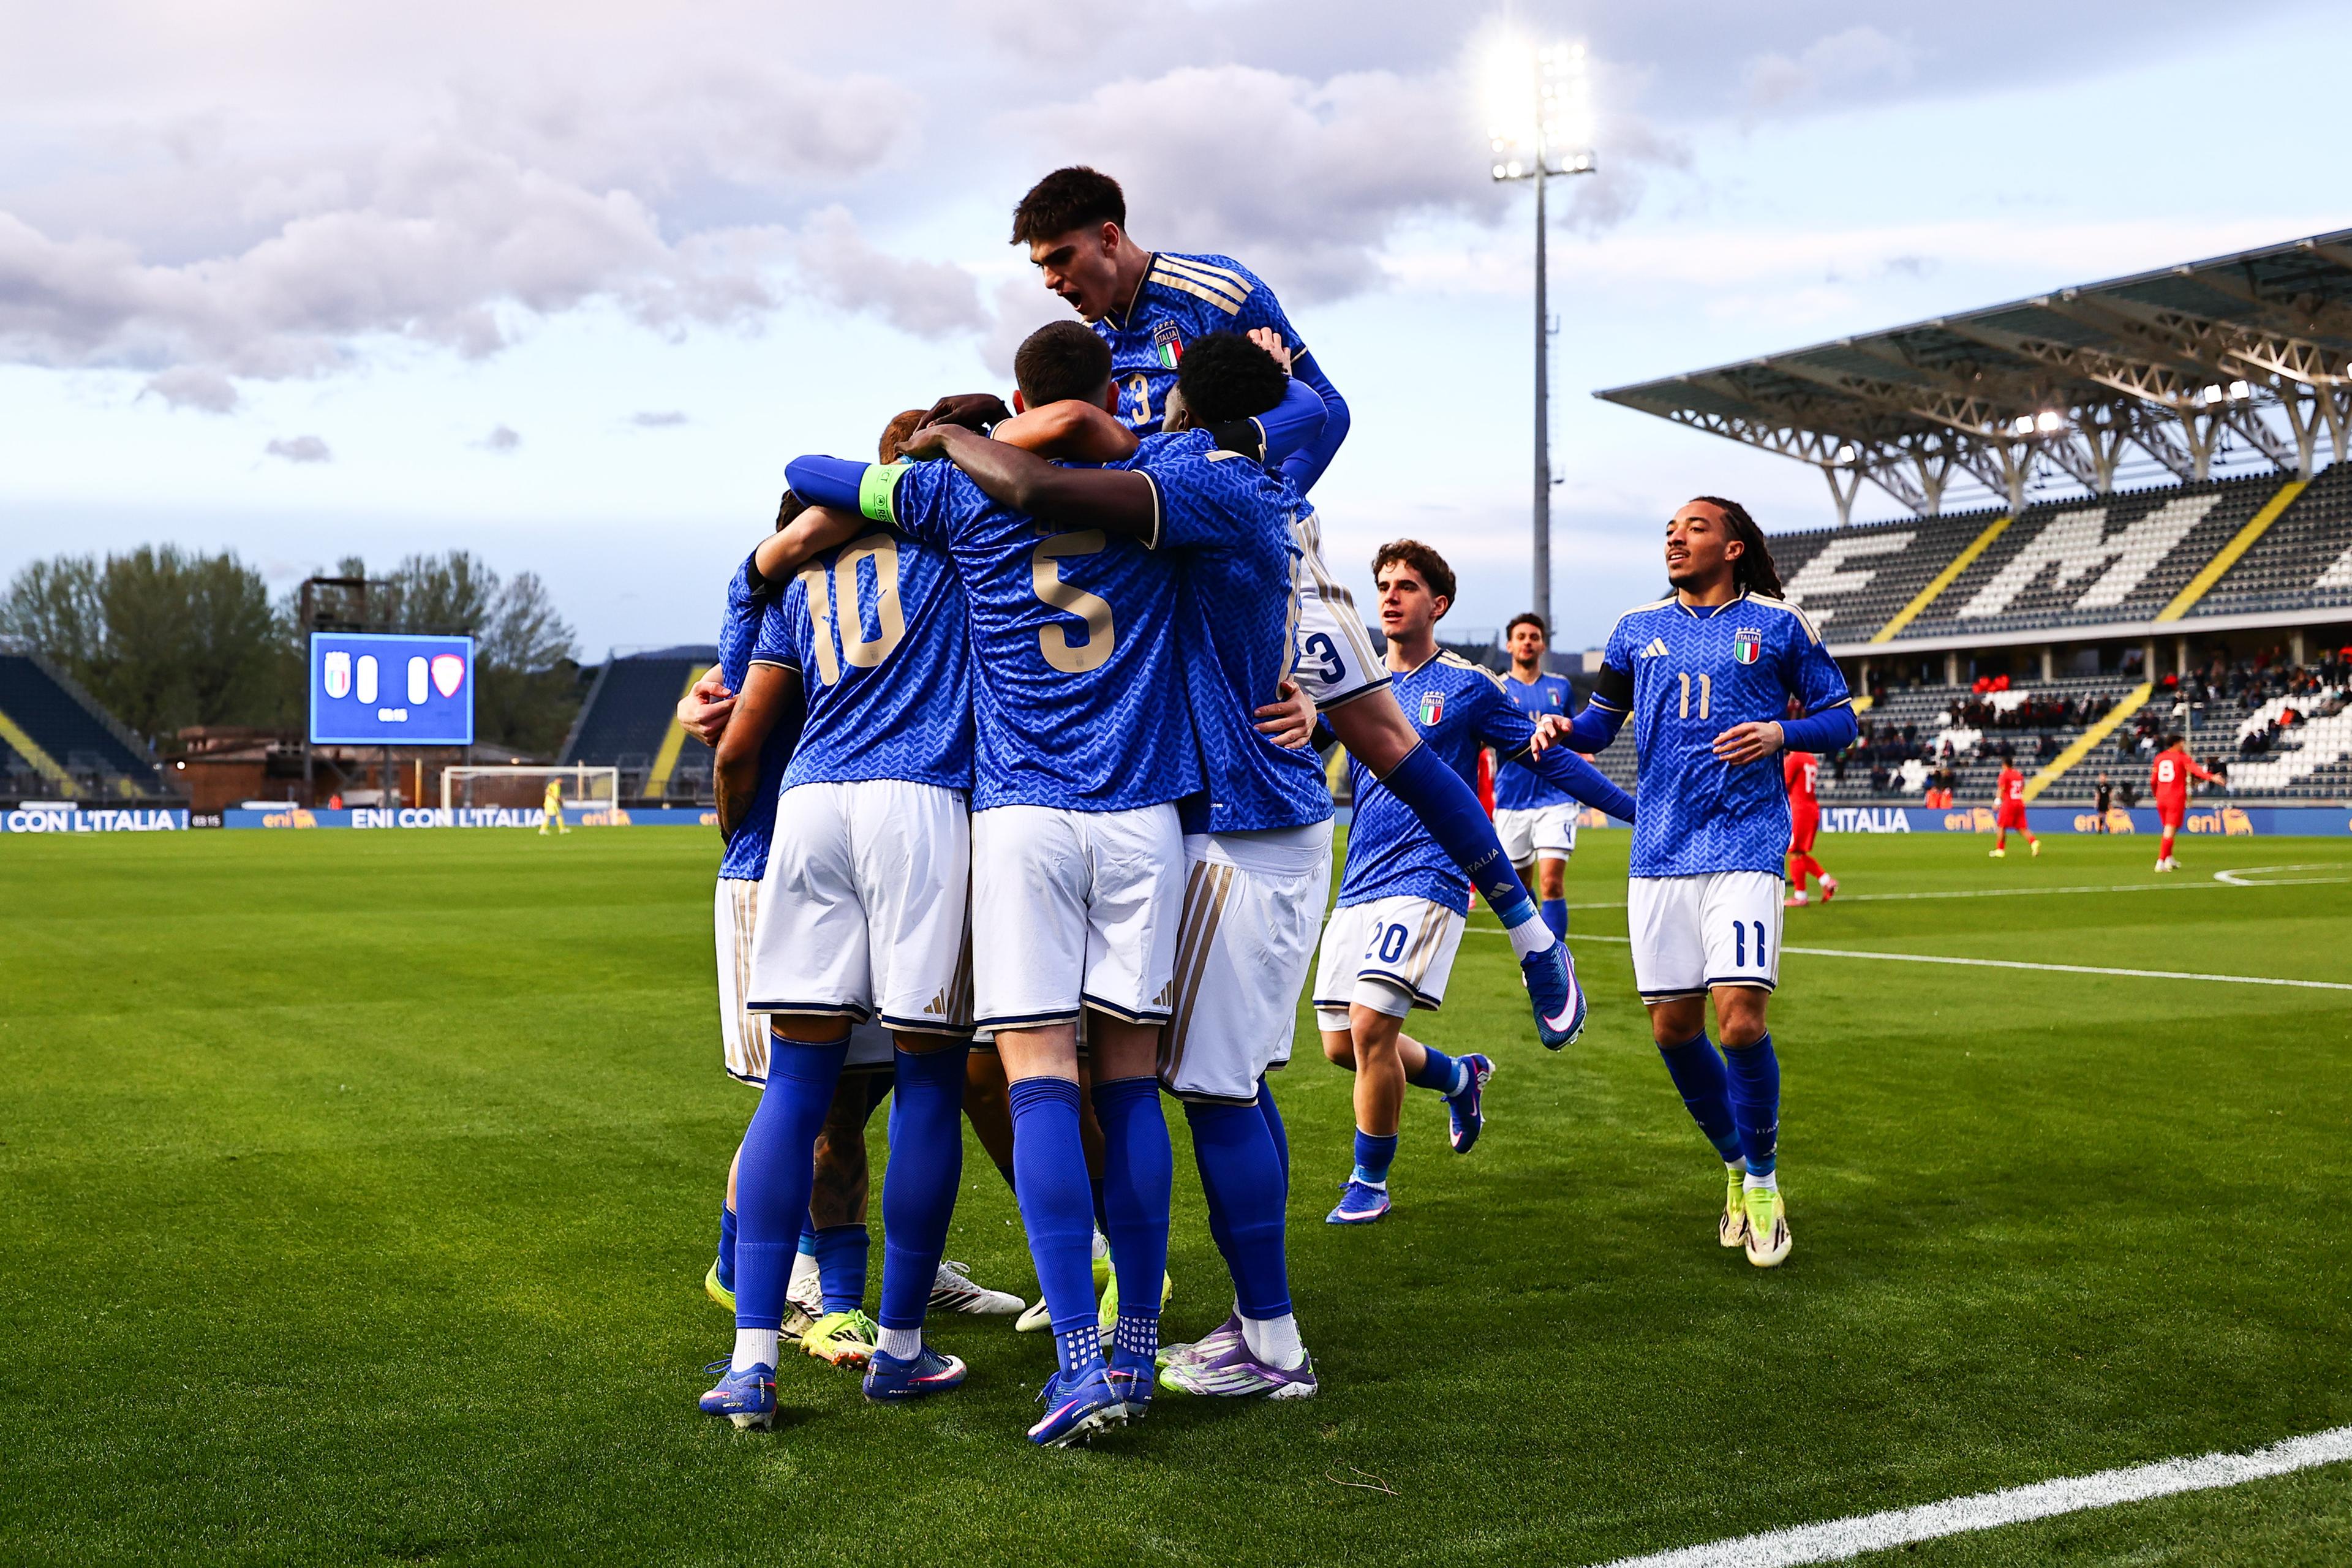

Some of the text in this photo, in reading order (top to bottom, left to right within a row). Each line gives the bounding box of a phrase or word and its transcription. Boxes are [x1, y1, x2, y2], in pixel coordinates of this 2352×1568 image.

[1156, 330, 1177, 344] ITALIA
[1129, 374, 1151, 425] 3
[797, 532, 906, 686] 10
[1032, 529, 1115, 674] 5
[1305, 632, 1346, 685] 3
[1678, 673, 1711, 720] 11
[2158, 760, 2175, 783] 8
[7, 810, 69, 832] CON
[74, 809, 176, 832] L'ITALIA
[263, 810, 293, 828] eni
[351, 808, 394, 829] ENI
[1822, 808, 1911, 834] L'ITALIA
[1944, 809, 1972, 831] eni
[2187, 809, 2222, 834] eni
[1464, 848, 1499, 875] ITALIA
[1365, 921, 1409, 963] 20
[1733, 920, 1765, 967] 11
